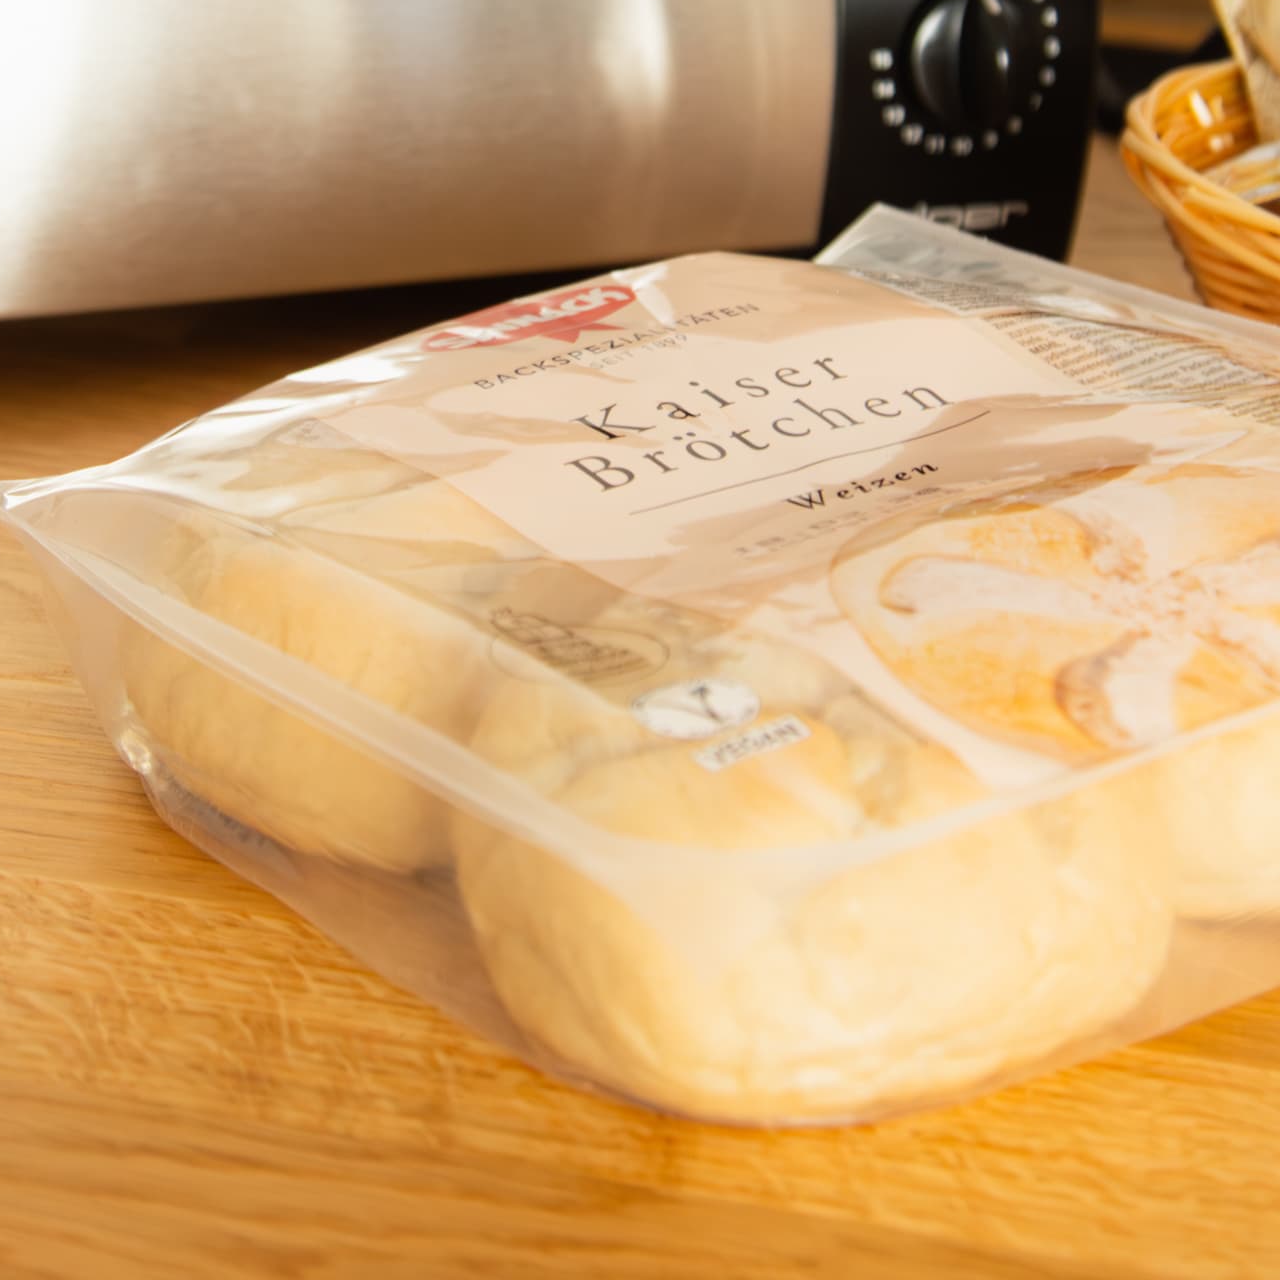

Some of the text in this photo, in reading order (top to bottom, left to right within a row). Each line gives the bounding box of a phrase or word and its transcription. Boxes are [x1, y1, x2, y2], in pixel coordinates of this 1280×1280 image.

[563, 379, 956, 494] Brötchen
[573, 353, 849, 442] Kaiser
[786, 461, 940, 512] Weizen
